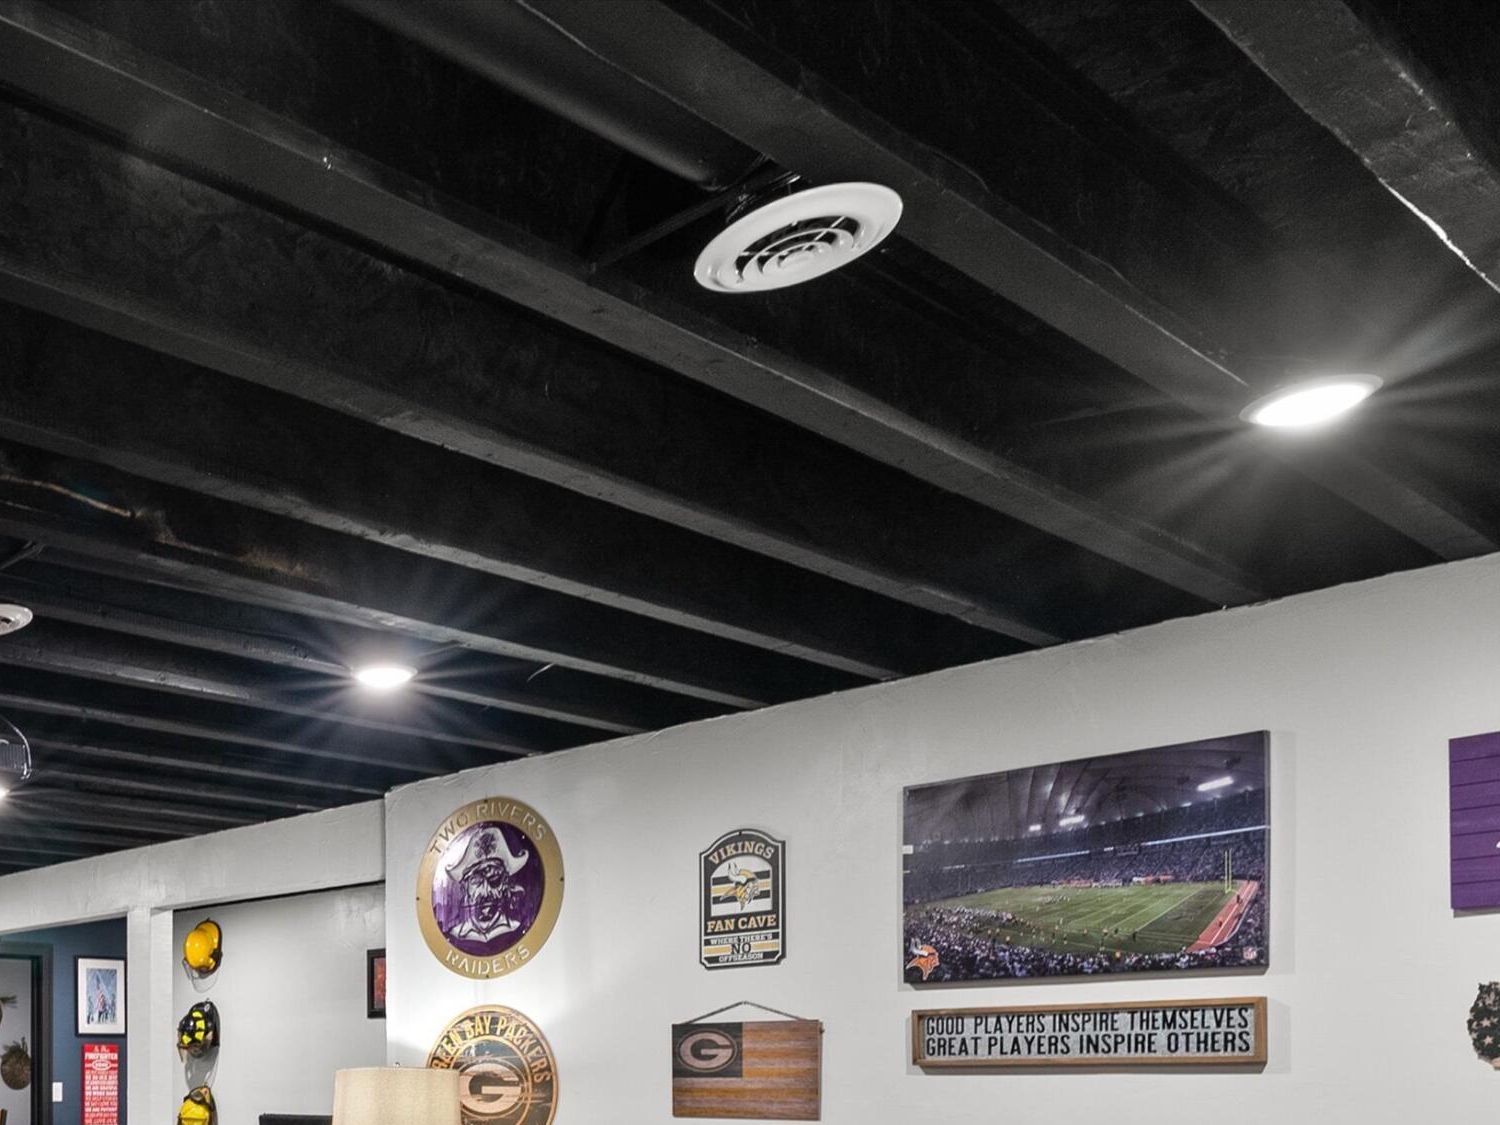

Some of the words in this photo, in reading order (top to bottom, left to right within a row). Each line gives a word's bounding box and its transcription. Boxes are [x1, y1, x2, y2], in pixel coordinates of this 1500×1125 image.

[429, 812, 469, 854] TWO
[476, 802, 547, 840] RIVERS
[708, 841, 774, 865] VIKINGS
[706, 919, 735, 933] FAN
[738, 914, 777, 930] CAVE
[710, 936, 739, 946] WHERE
[740, 933, 773, 943] THERE'S
[731, 942, 752, 955] NO
[446, 944, 530, 975] RAIDERS
[718, 952, 764, 963] OFFSEASON
[926, 1016, 964, 1036] GOOD
[974, 1013, 1046, 1034] PLAYERS
[1052, 1010, 1120, 1033] INSPIRE
[1129, 1007, 1249, 1031] THEMSELVES
[431, 1027, 466, 1070] REEN
[466, 1014, 492, 1042] BAY
[496, 1015, 550, 1084] PACKERS
[926, 1036, 982, 1056] GREAT
[988, 1034, 1071, 1055] PLAYERS
[1079, 1033, 1157, 1054] INSPIRE
[1167, 1031, 1251, 1053] OTHERS
